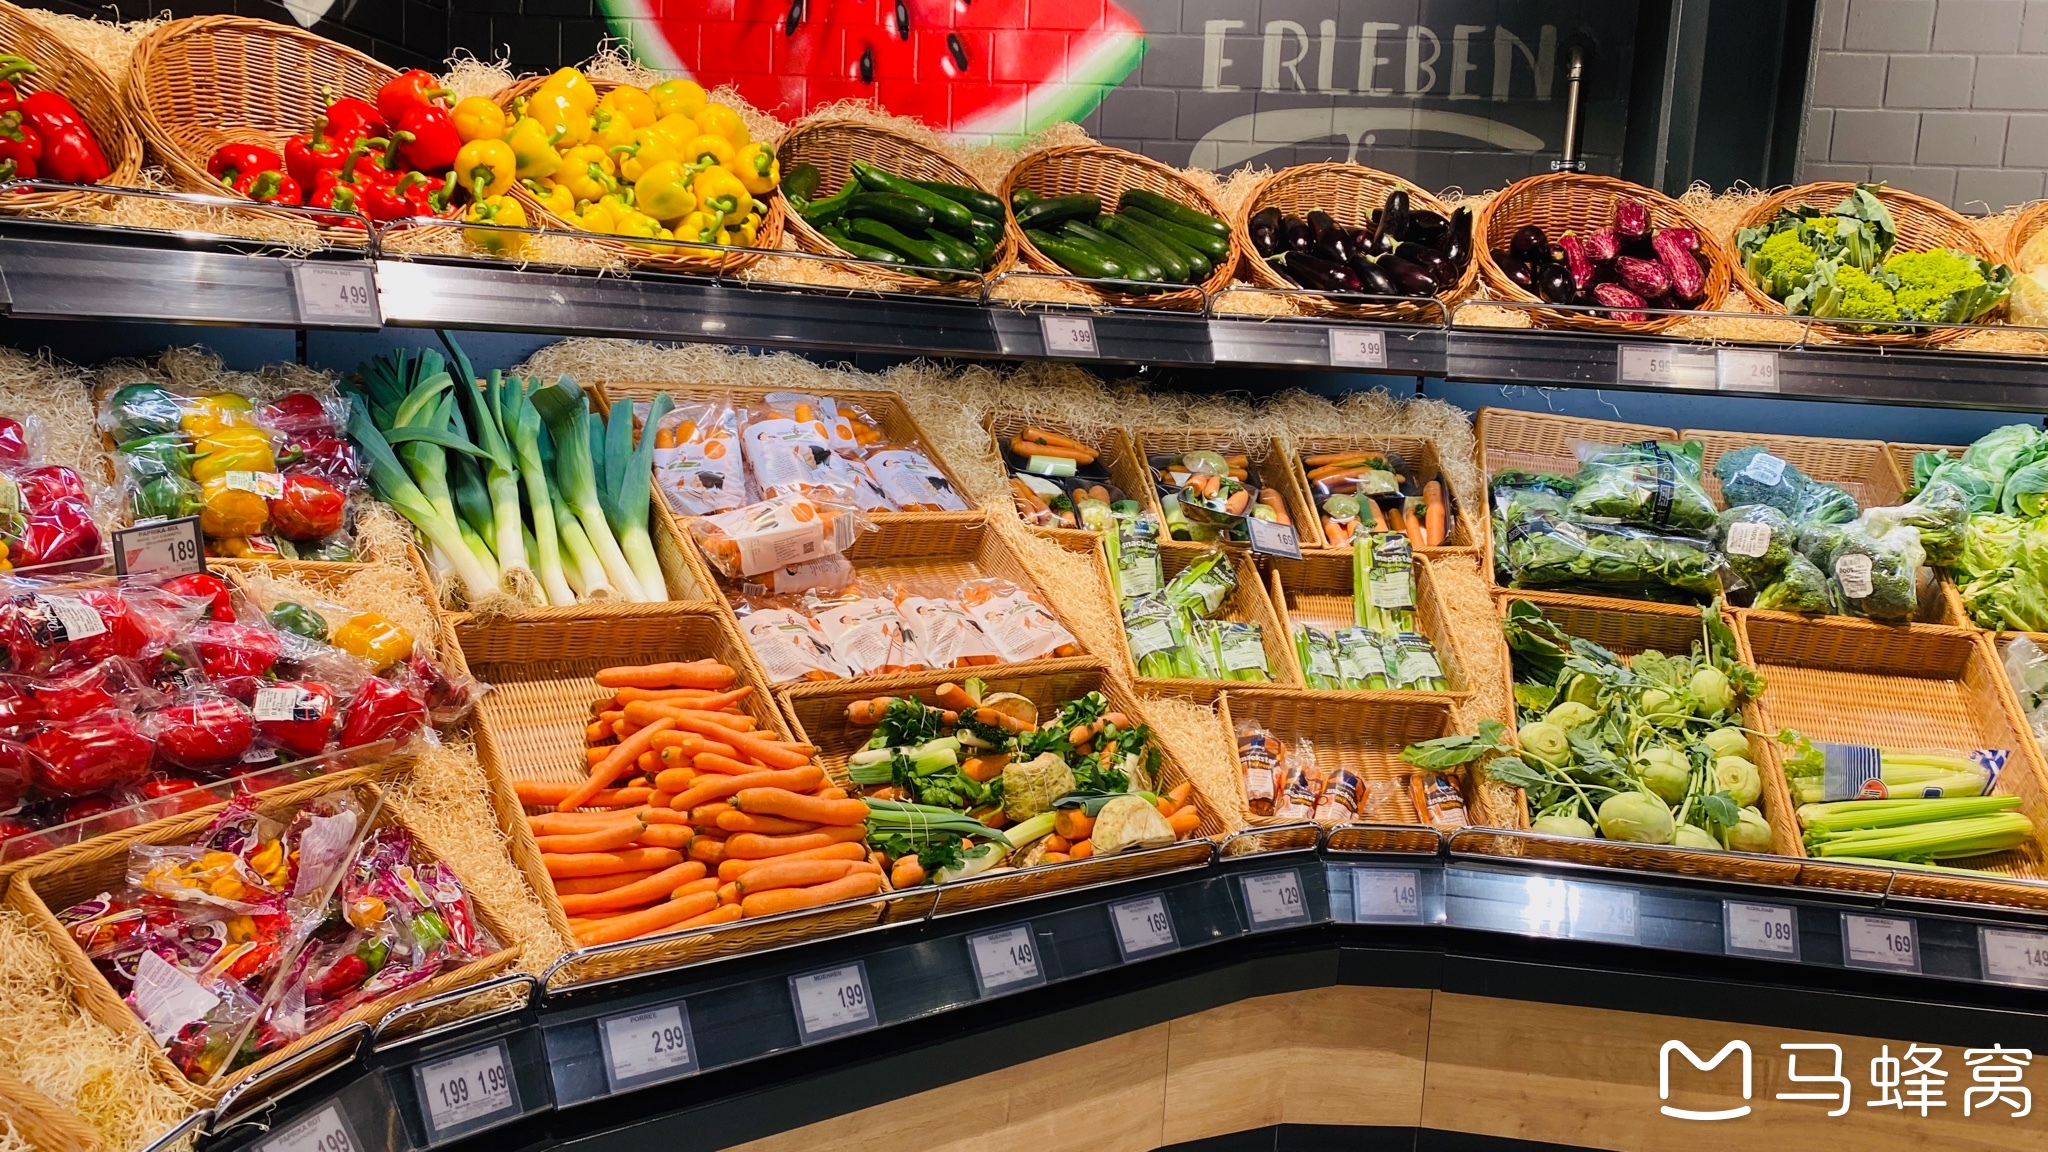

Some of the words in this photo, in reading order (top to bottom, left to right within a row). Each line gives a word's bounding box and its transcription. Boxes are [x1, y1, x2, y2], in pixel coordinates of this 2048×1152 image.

[1202, 19, 1557, 101] ERLEBEN
[168, 539, 196, 563] 1,89
[1278, 886, 1299, 906] 1,29
[1147, 912, 1167, 933] 1,69
[1010, 943, 1032, 966] 1,49
[1886, 933, 1911, 953] 1,69
[837, 983, 864, 1009] 1,99
[630, 1012, 657, 1024] PORREE
[651, 1025, 684, 1054] 2,99
[440, 1077, 469, 1109] 1,99
[478, 1065, 507, 1096] 1,99
